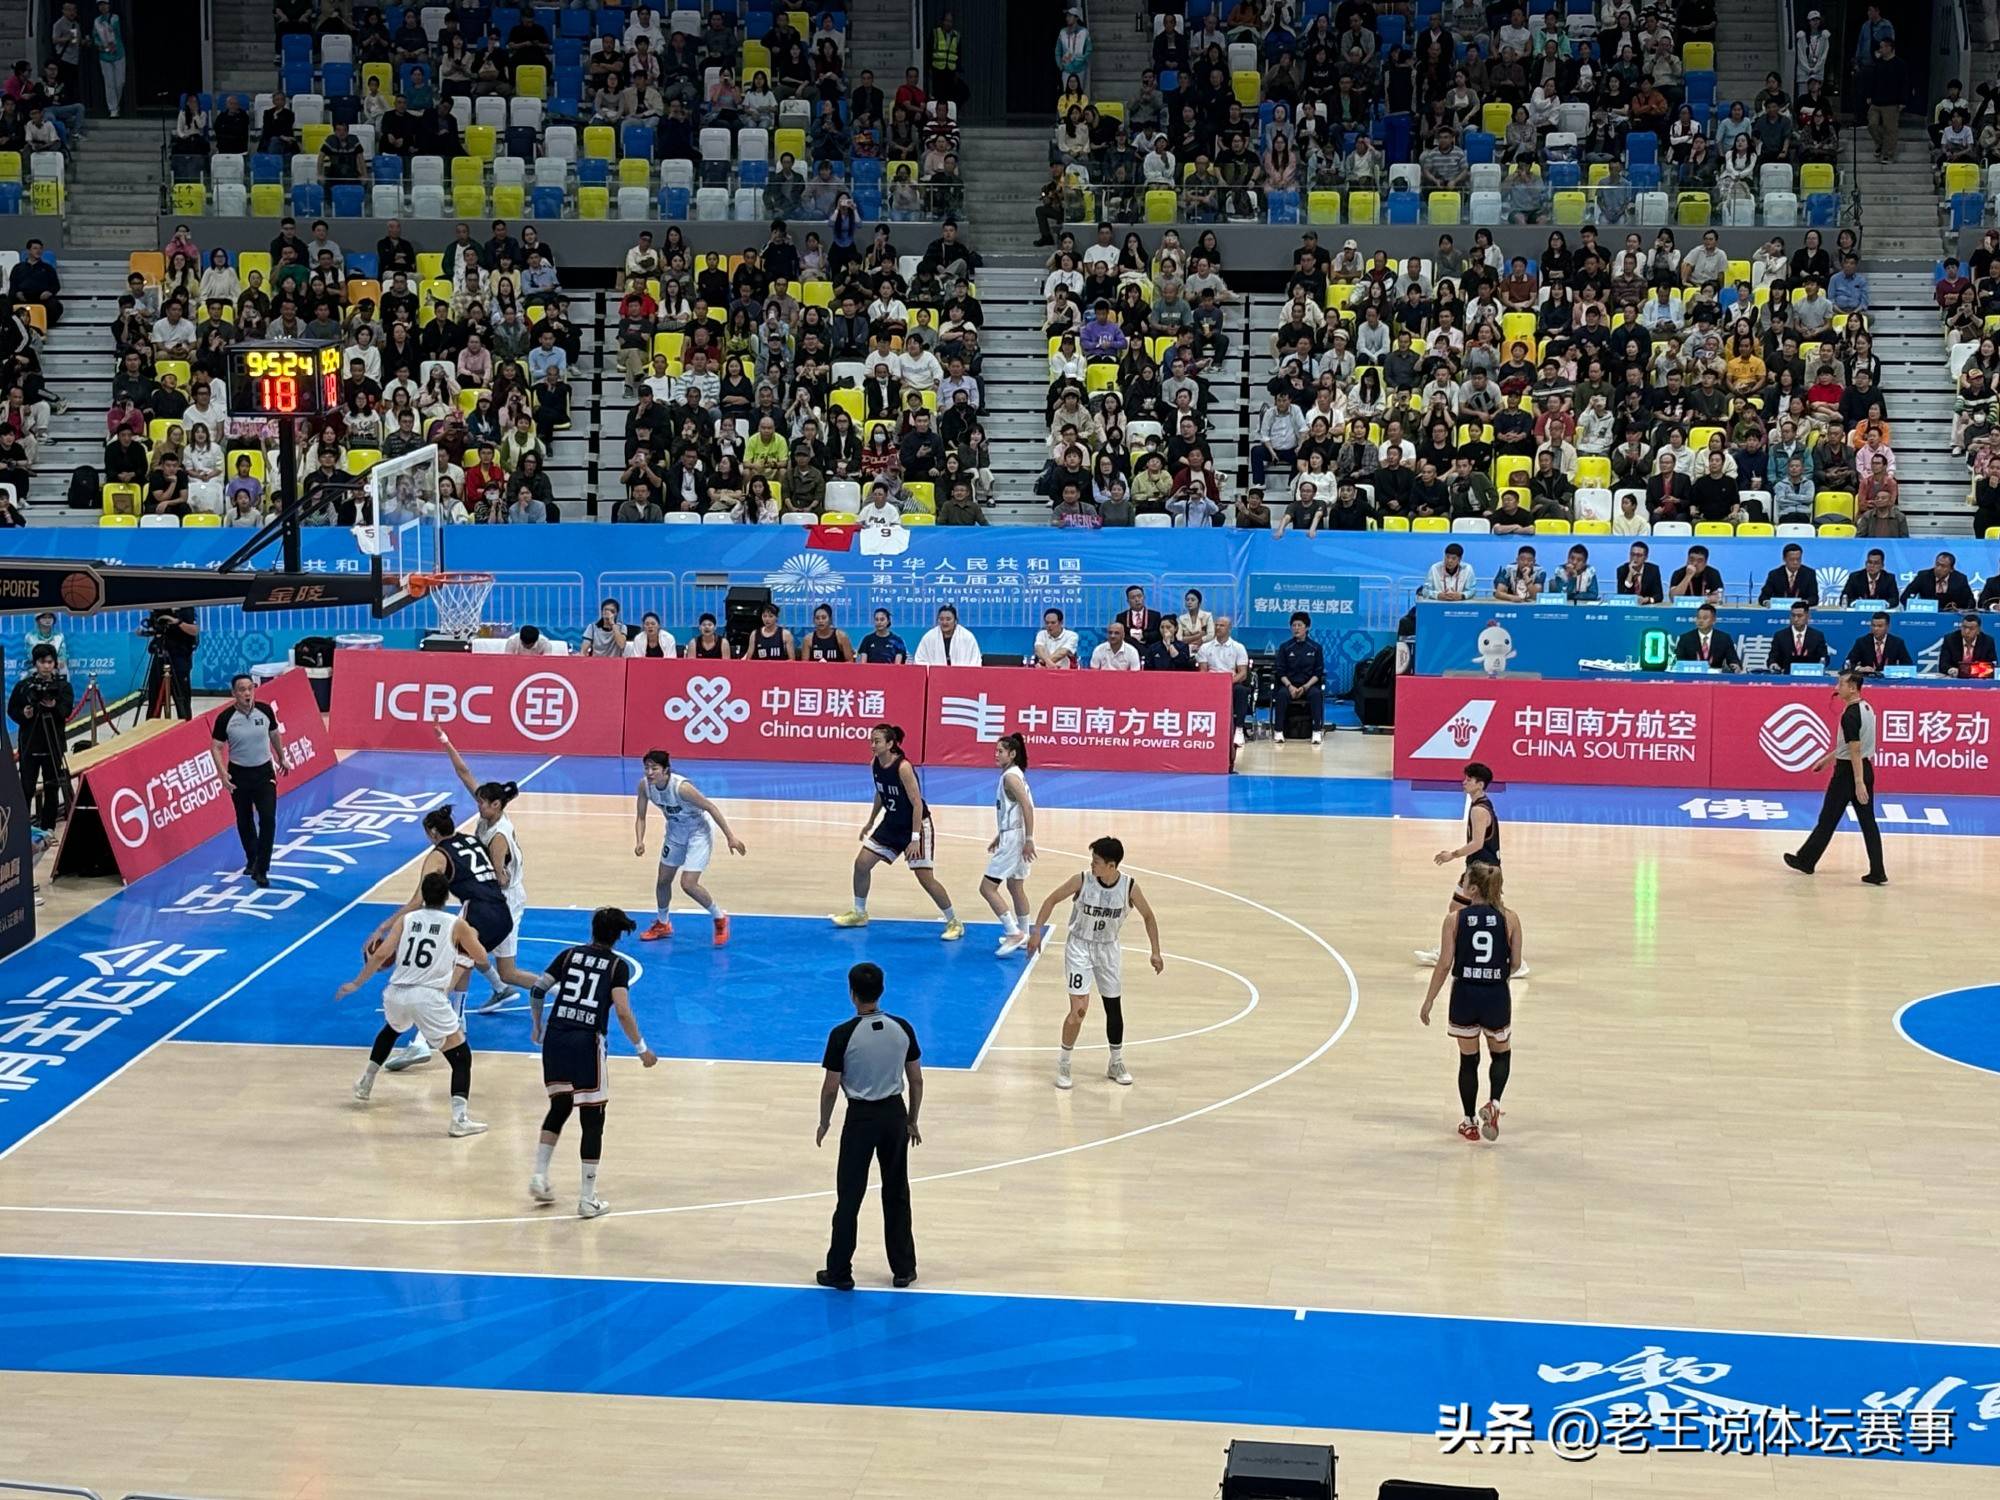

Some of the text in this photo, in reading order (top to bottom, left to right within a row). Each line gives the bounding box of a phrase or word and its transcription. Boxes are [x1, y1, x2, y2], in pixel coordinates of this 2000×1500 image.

[881, 528, 891, 538] 9
[873, 557, 1081, 571] 中华人民共和国
[0, 579, 40, 598] PORTS
[872, 573, 1082, 585] 第十五届运动会
[942, 587, 1005, 595] National
[1254, 598, 1354, 614] 客队球员坐席区
[89, 658, 115, 668] 2025
[374, 681, 494, 724] ICBC
[760, 686, 886, 719] 中国联通
[759, 720, 873, 740] China unico
[1017, 704, 1217, 738] 中国南方电网
[1514, 704, 1697, 741] 中国南方航空
[1874, 709, 1990, 745] 国移动
[1060, 735, 1130, 748] SOUTHERN
[1132, 738, 1180, 749] POWER
[1183, 740, 1216, 750] GRID
[1511, 737, 1696, 763] CHINA SOUTHERN
[1915, 748, 1989, 770] Mobile
[146, 749, 219, 812] 广汽集团
[152, 778, 224, 830] GAC GROUP
[1093, 919, 1106, 932] 18
[401, 936, 437, 969] 16
[1471, 930, 1494, 963] 9
[562, 967, 601, 1008] 31
[1068, 972, 1083, 989] 18
